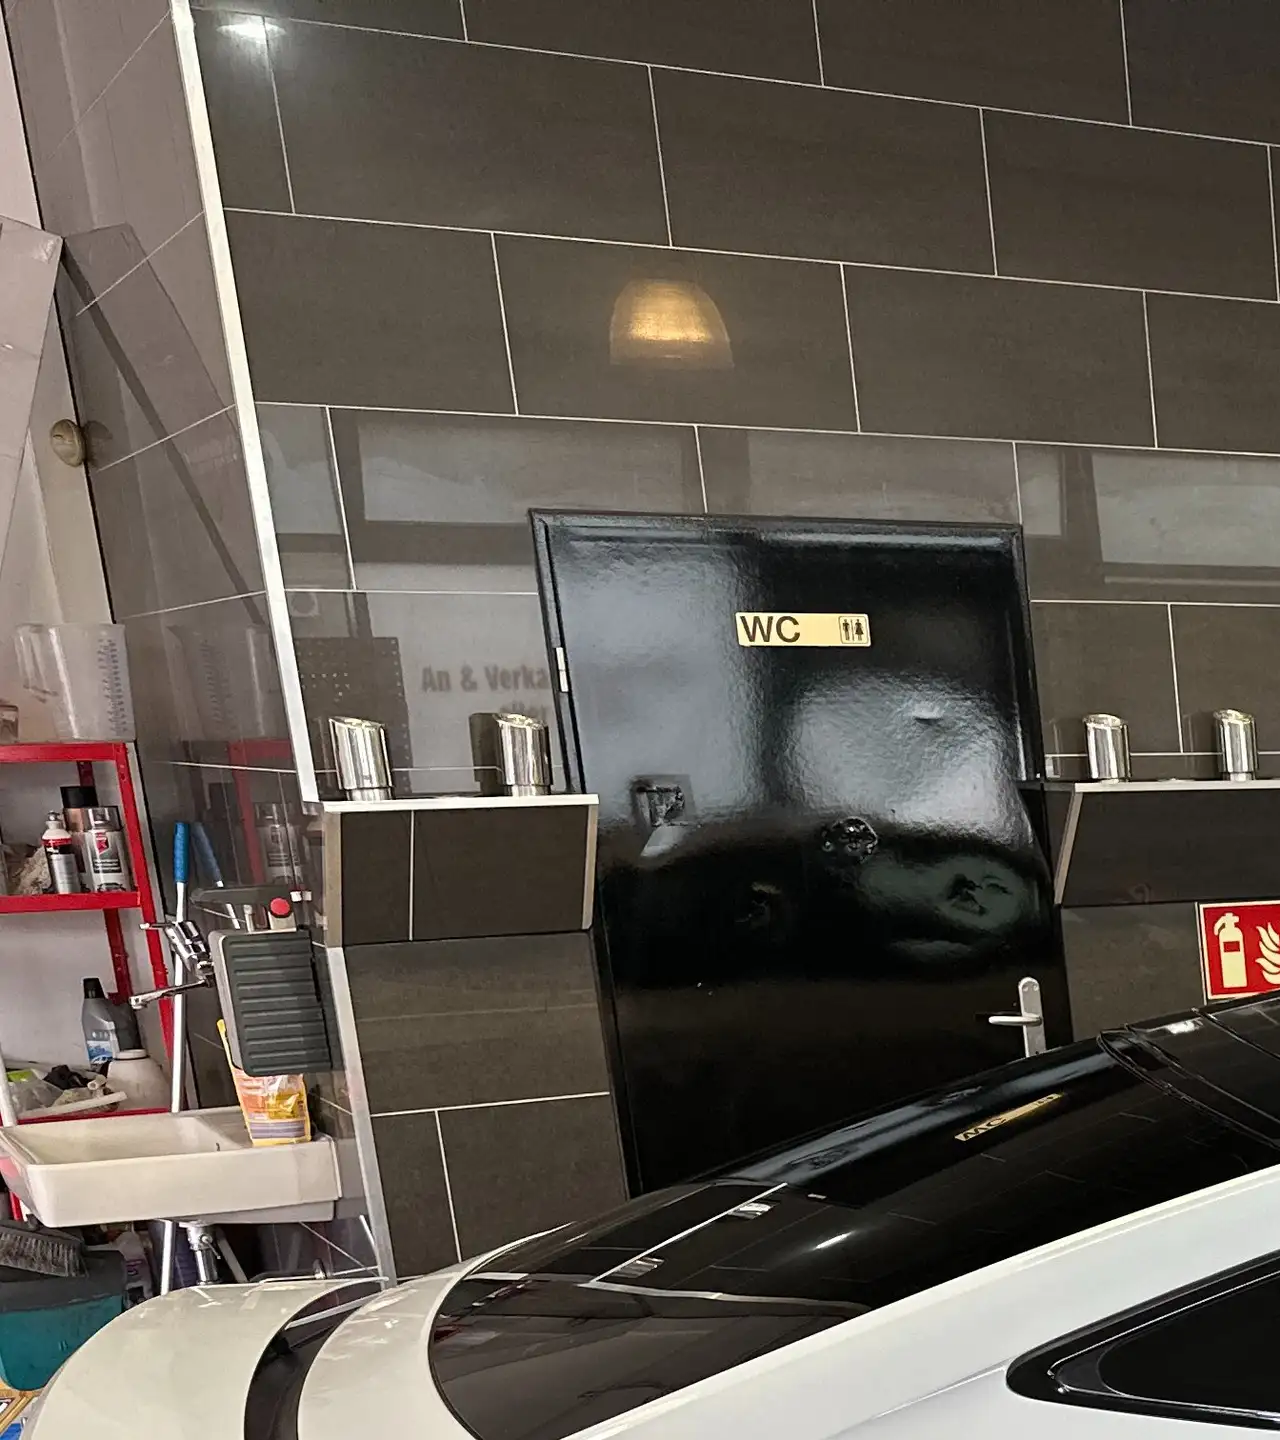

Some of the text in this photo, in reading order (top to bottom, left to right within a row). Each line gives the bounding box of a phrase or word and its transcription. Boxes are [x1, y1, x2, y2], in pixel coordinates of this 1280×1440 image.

[740, 615, 801, 643] WC
[421, 666, 452, 692] An
[459, 664, 478, 691] &
